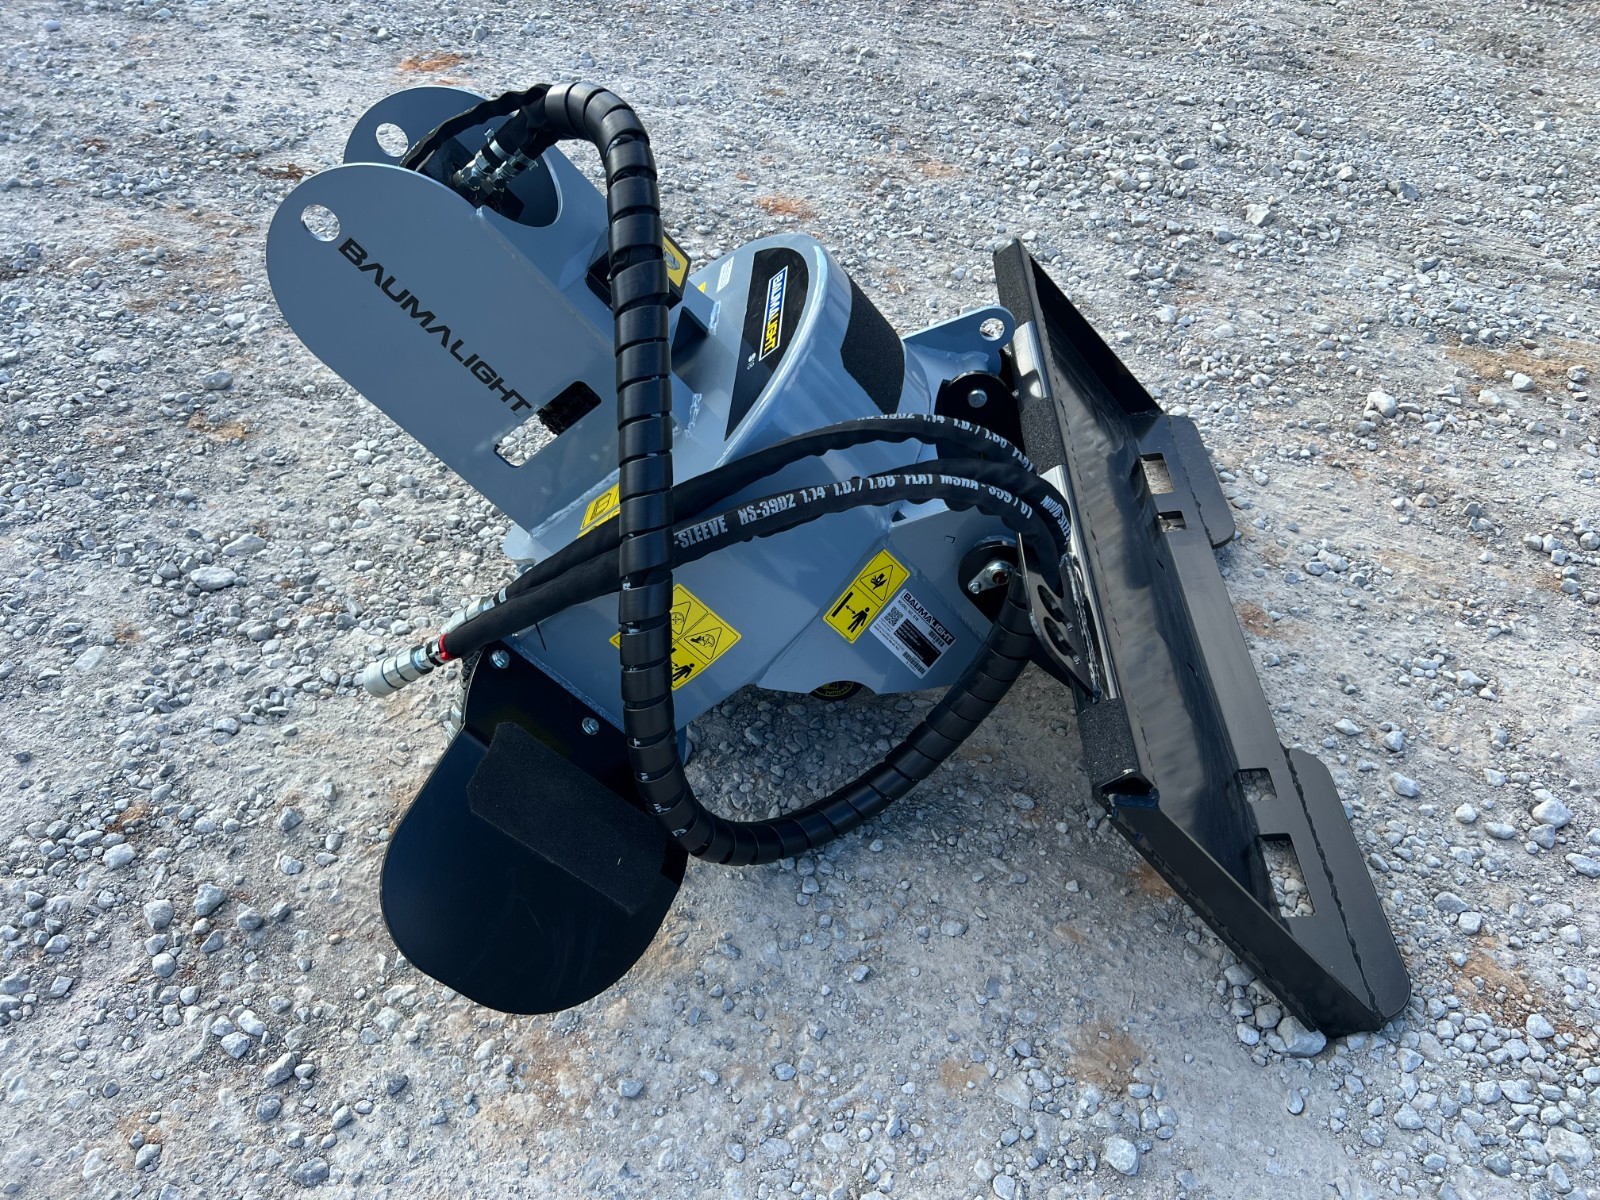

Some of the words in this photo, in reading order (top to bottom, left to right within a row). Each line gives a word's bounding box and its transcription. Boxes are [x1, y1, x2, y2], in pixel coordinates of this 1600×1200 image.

[338, 237, 532, 412] BAUMALIGHT
[764, 272, 784, 354] BAUMALIGHT
[737, 493, 797, 526] NS-3902
[903, 592, 954, 642] BAUMALIGHT
